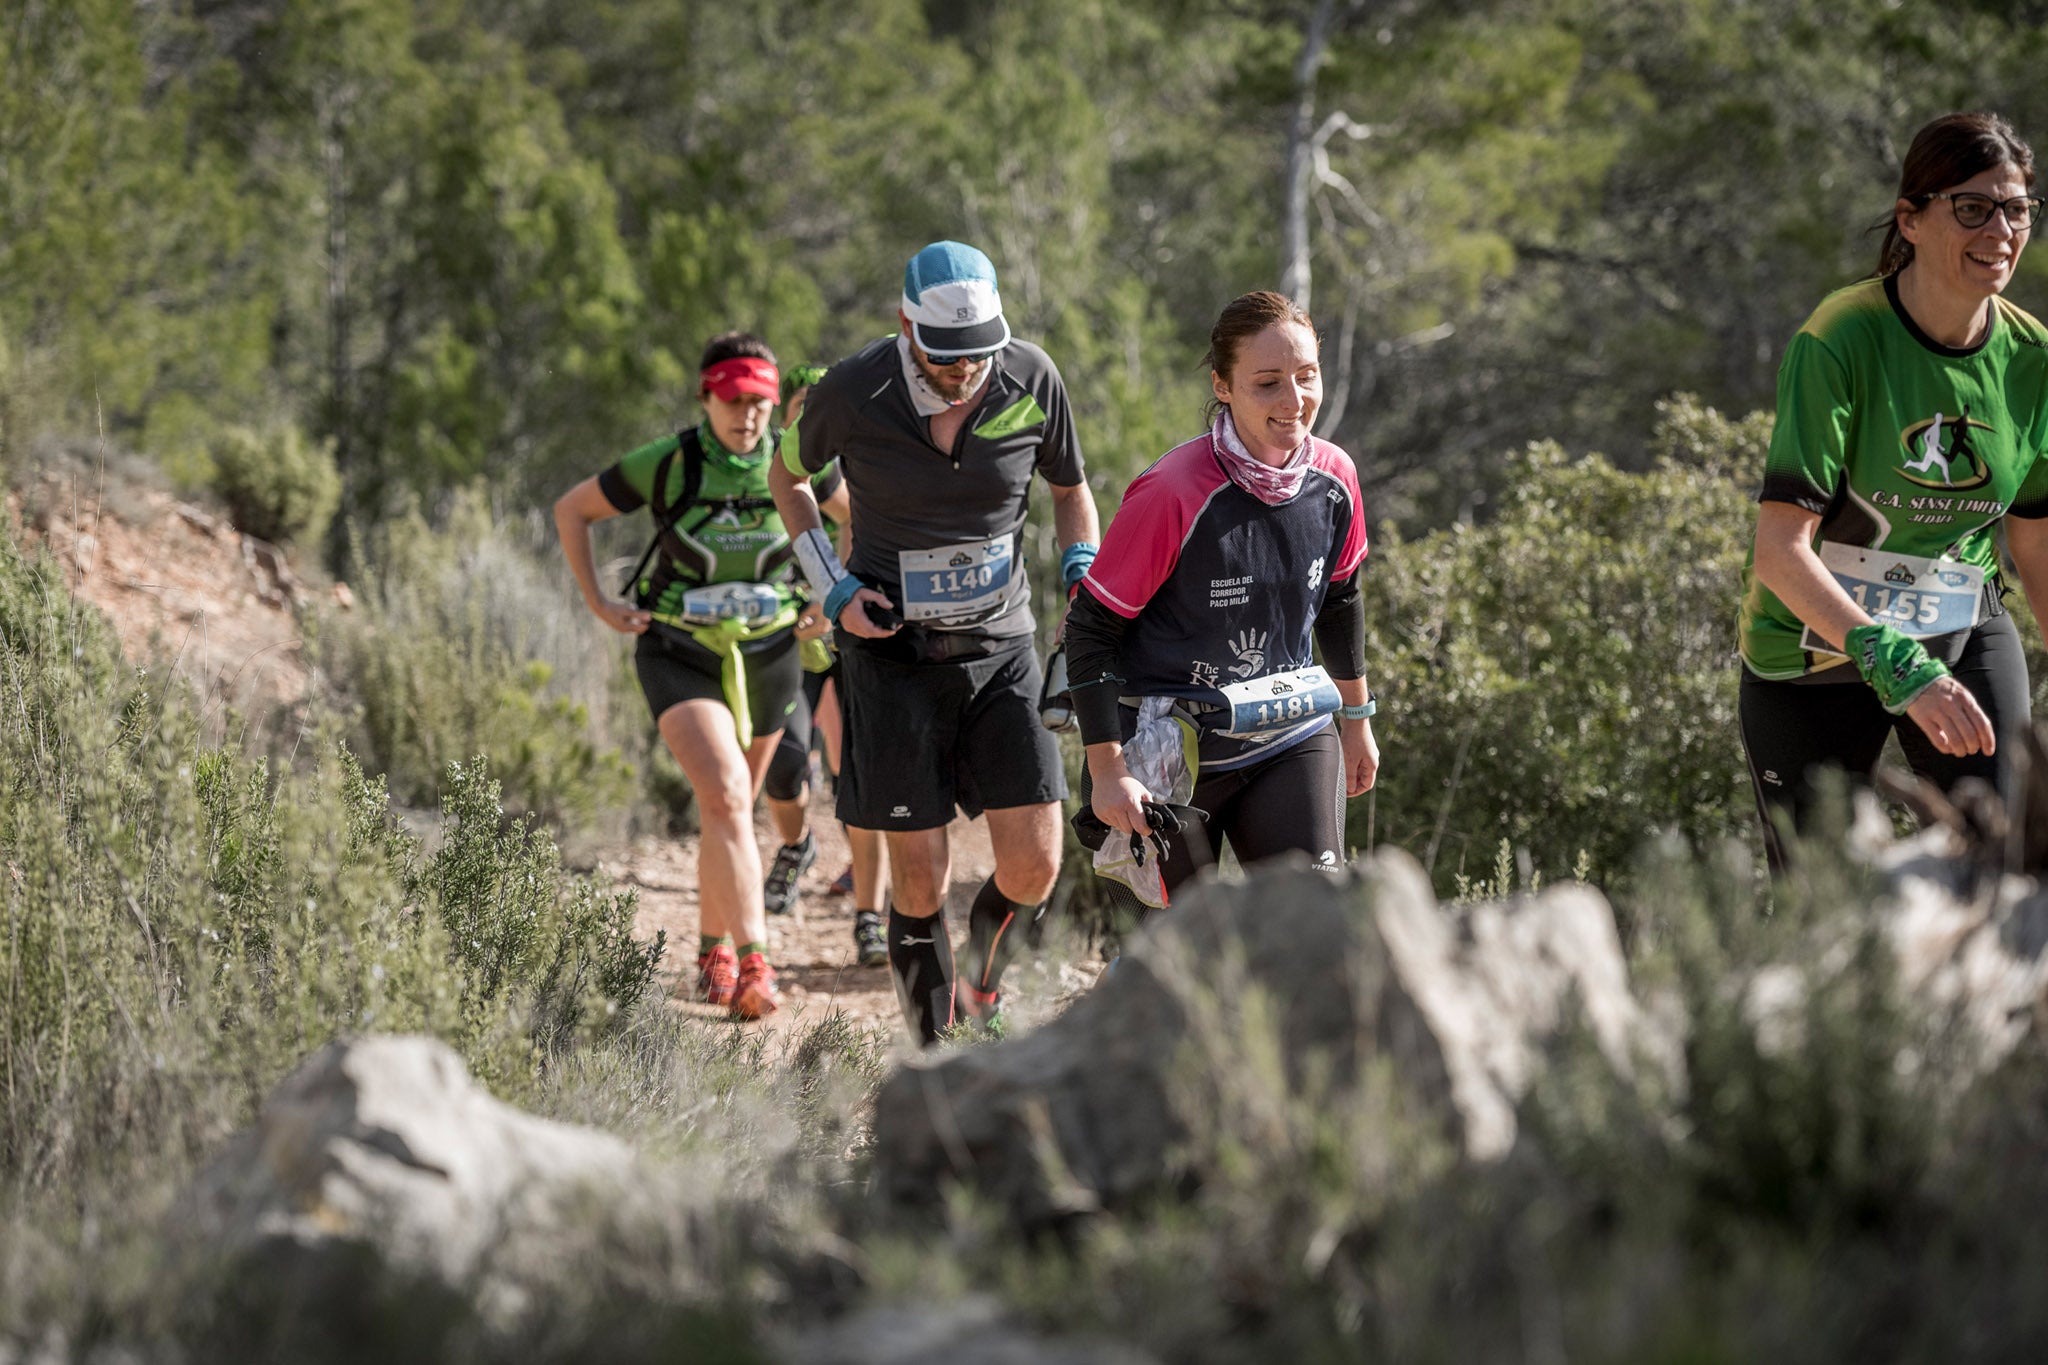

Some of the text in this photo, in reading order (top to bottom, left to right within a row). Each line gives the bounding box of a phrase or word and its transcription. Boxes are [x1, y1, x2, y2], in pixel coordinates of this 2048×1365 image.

[1909, 497, 1955, 510] SENSE
[930, 565, 992, 594] 1140
[1210, 575, 1254, 588] ESCUELA DEL
[1210, 587, 1246, 597] CORREDOR
[1210, 599, 1229, 607] PACO
[1852, 584, 1941, 624] 1155
[1192, 660, 1219, 675] The
[1257, 693, 1317, 726] 1181
[1311, 864, 1339, 873] VIATOR
